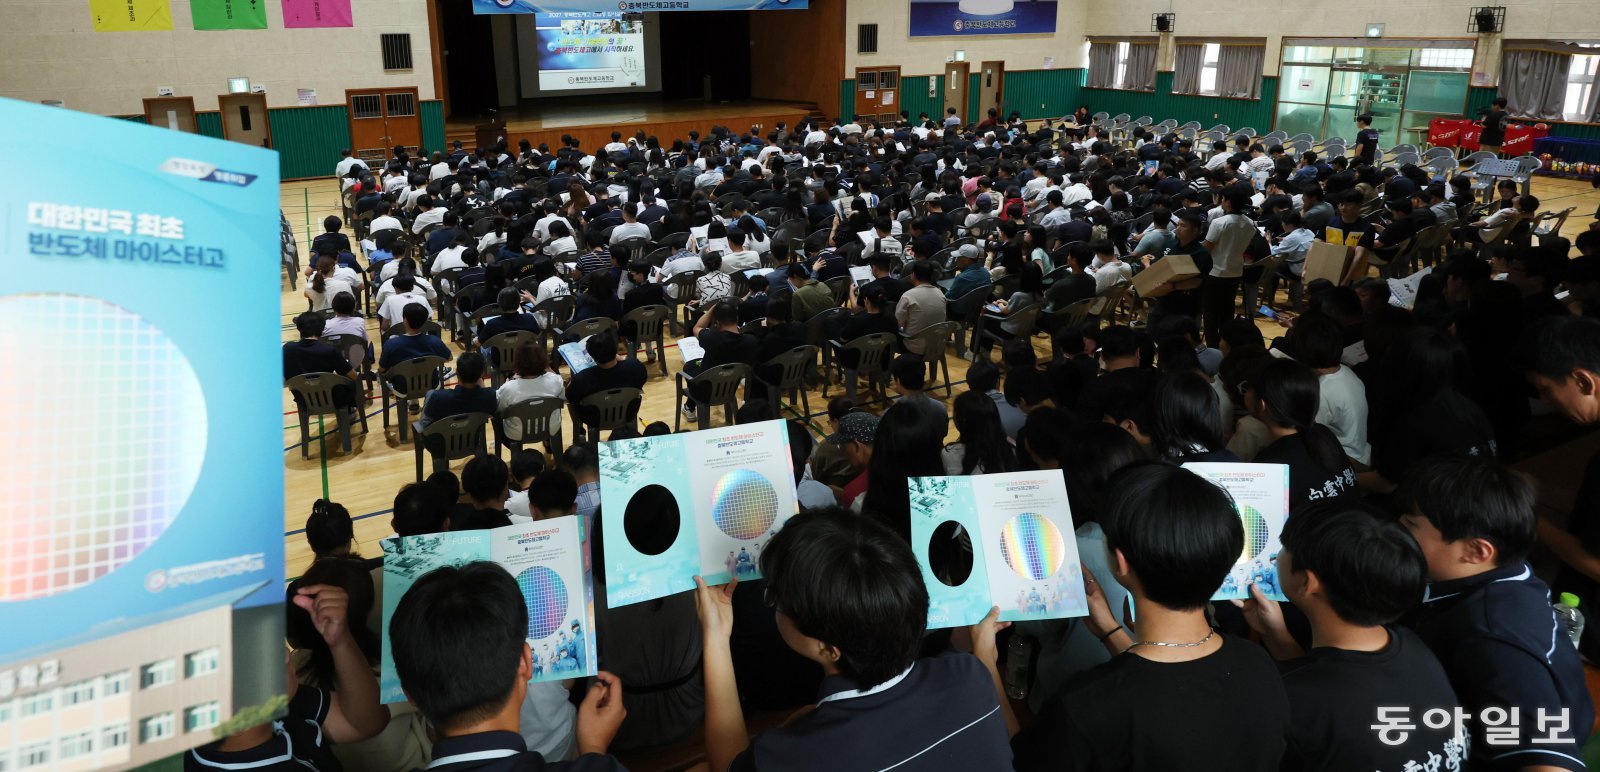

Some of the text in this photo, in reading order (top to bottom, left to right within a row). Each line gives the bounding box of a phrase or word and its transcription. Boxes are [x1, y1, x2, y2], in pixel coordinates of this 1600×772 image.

[628, 1, 689, 10] 충북반도체고등학교
[28, 202, 184, 240] 대한민국 최초
[29, 232, 224, 268] 반도체 마이스터고
[452, 535, 482, 545] FUTURE
